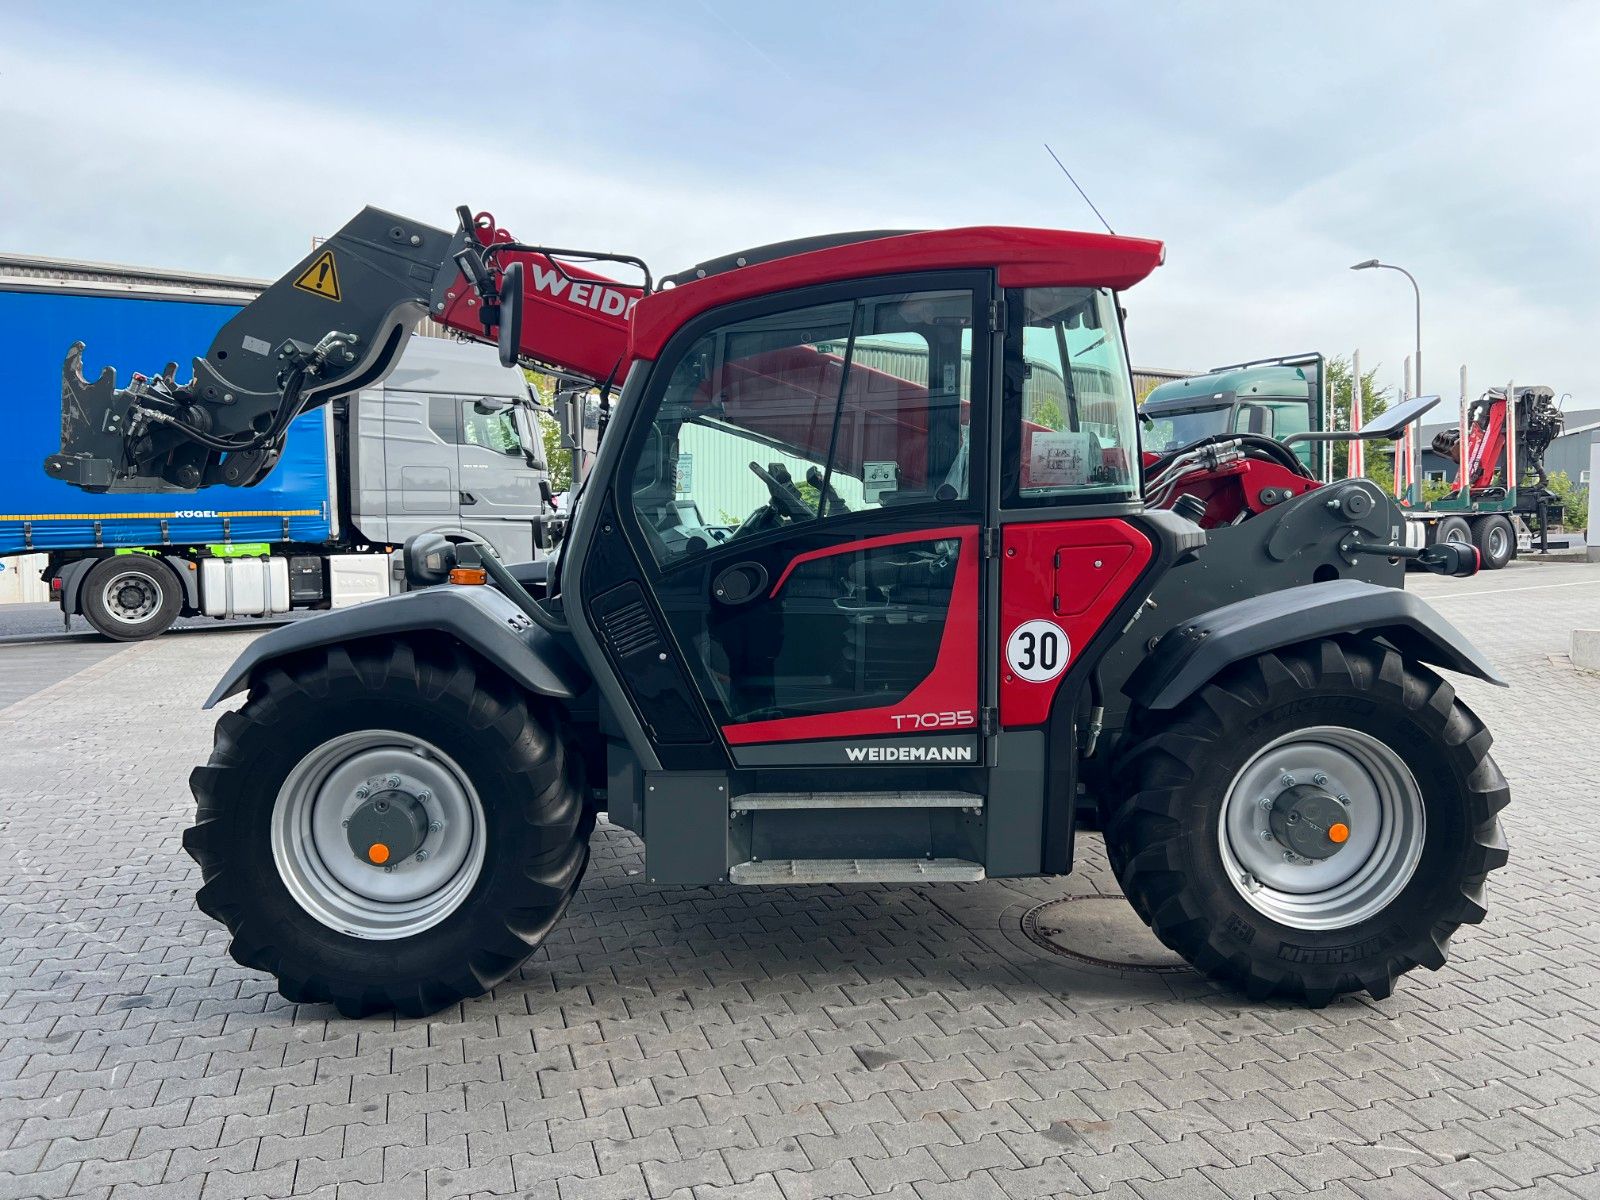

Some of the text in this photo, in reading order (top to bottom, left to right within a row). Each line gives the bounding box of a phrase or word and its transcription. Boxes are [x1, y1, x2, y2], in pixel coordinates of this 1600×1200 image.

[175, 510, 218, 518] KÖGEL
[1018, 631, 1058, 671] 30
[891, 710, 974, 729] T7035
[845, 747, 971, 761] WEIDEMANN
